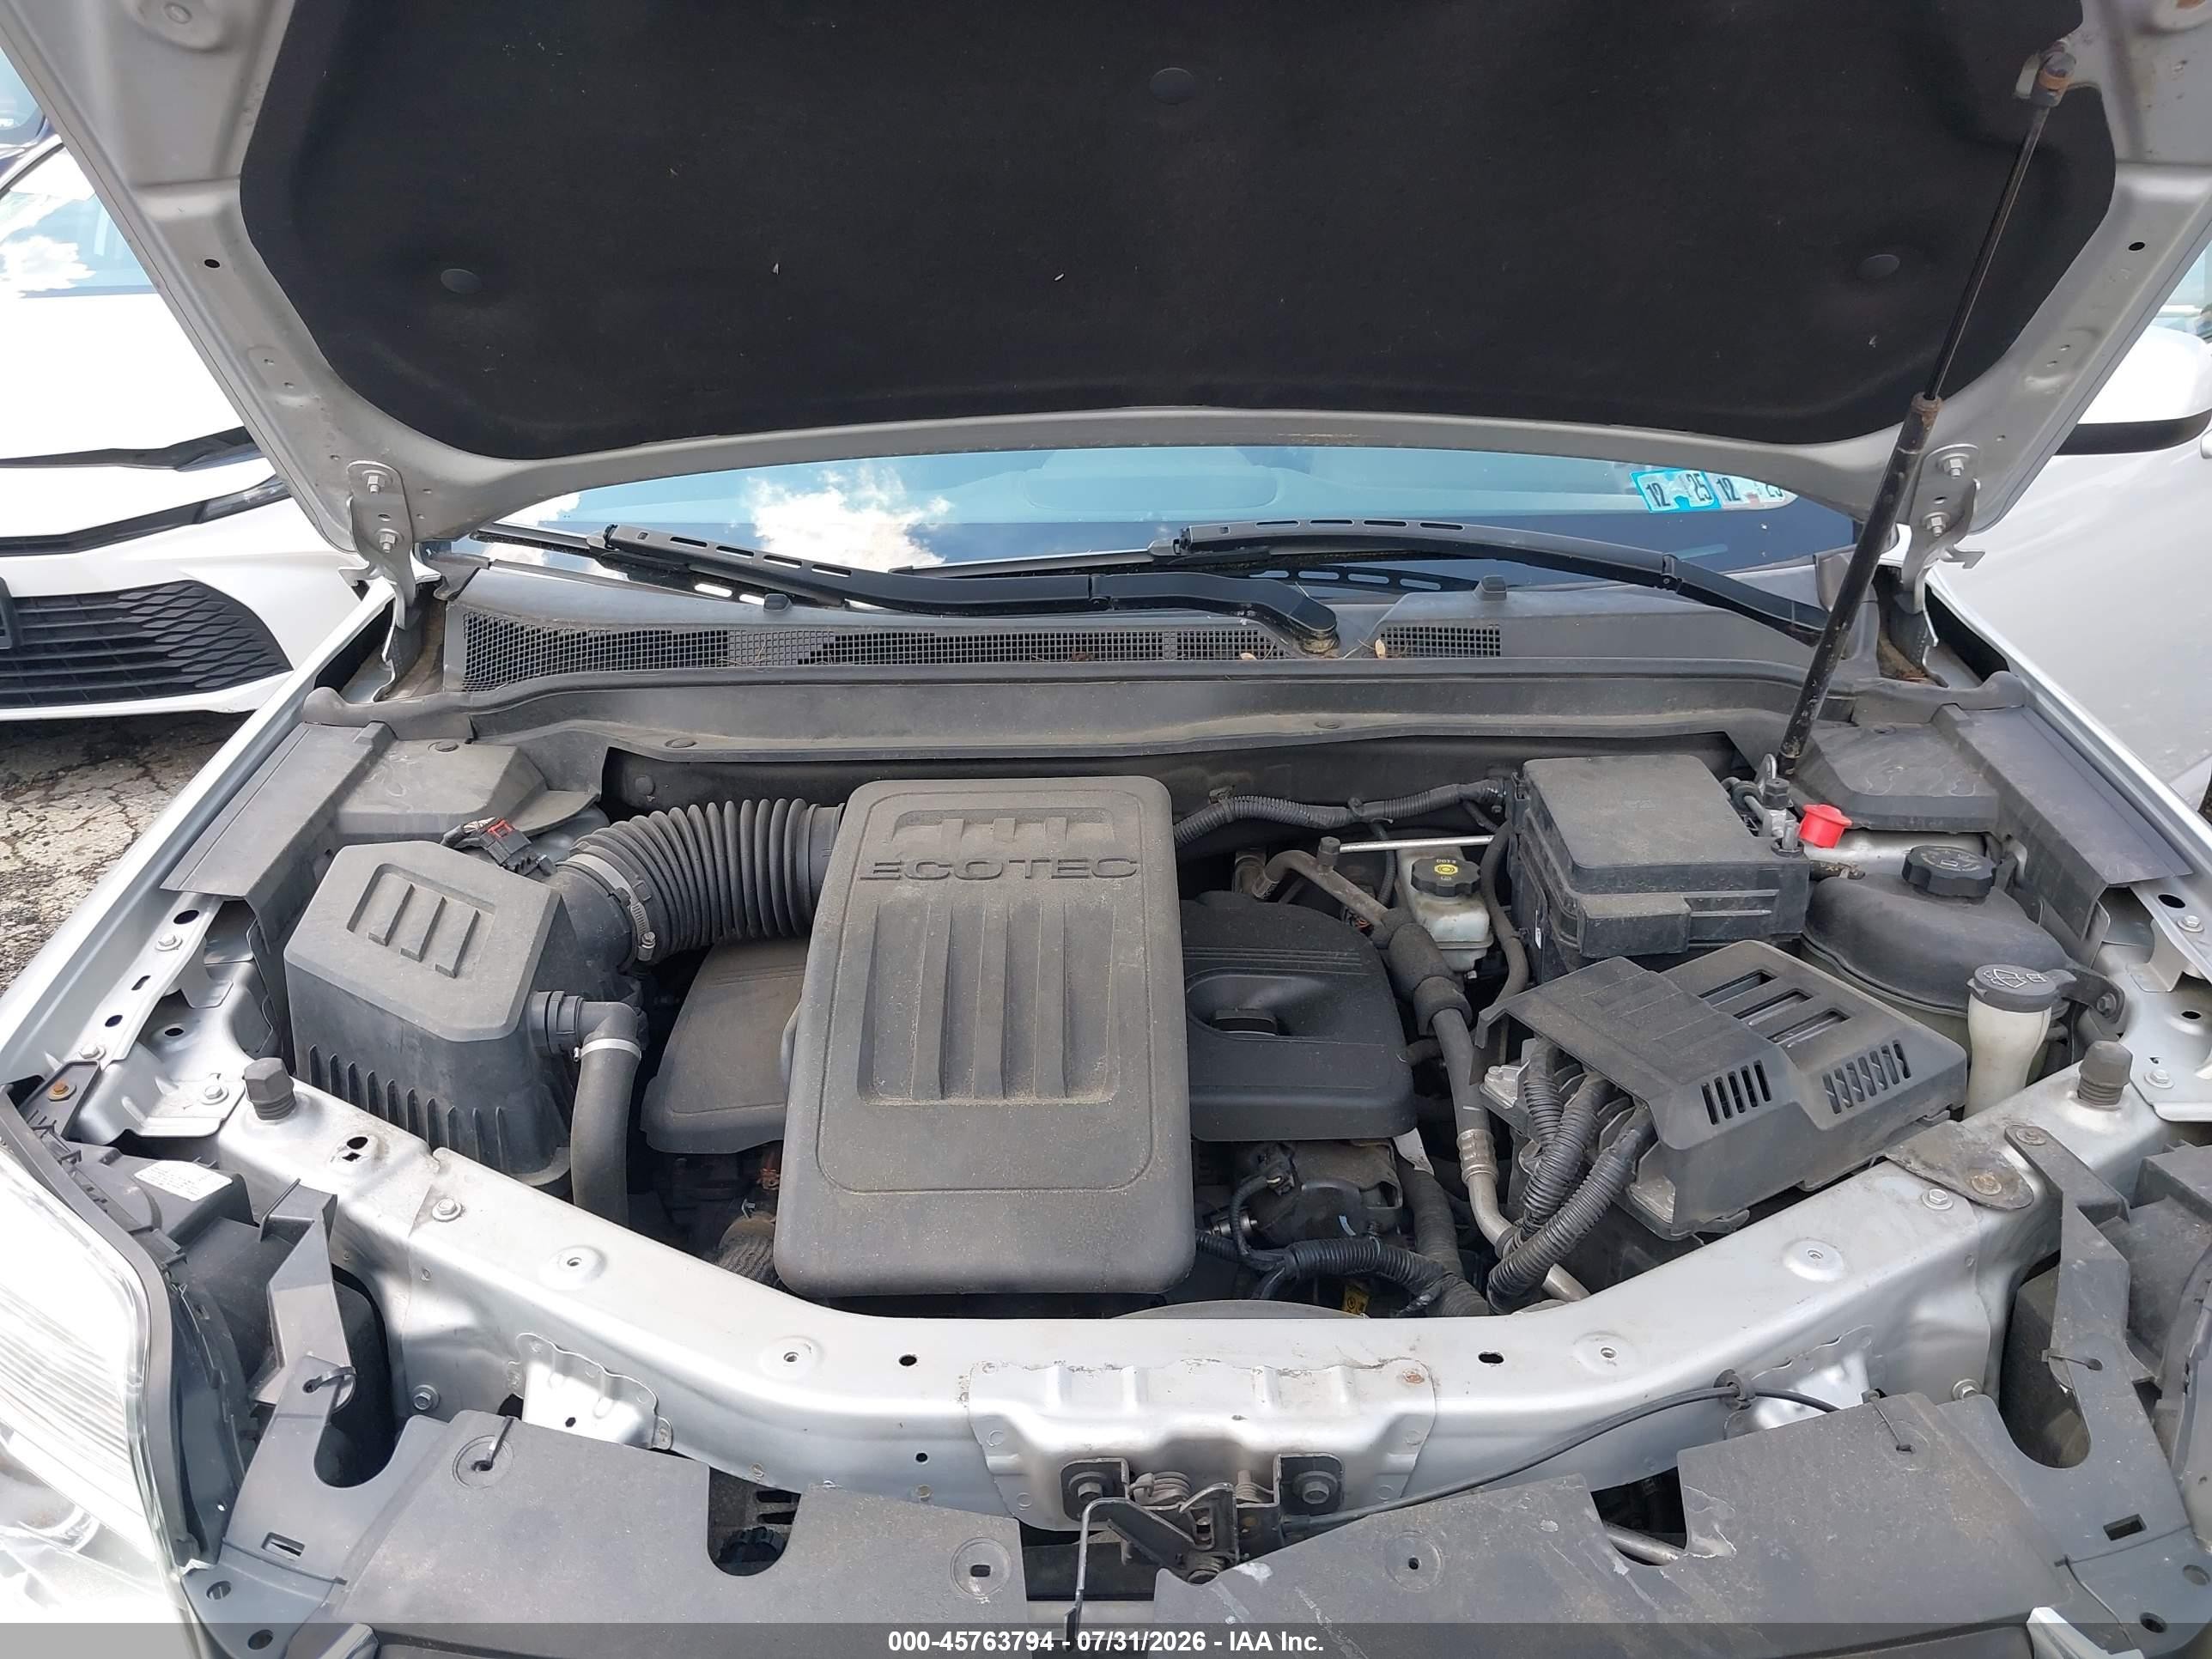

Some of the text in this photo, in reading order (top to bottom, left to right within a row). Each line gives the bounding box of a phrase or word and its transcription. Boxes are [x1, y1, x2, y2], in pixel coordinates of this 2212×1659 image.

[1646, 473, 1712, 507] 12 25
[1717, 477, 1741, 501] 12
[860, 859, 1137, 880] ECOTEC
